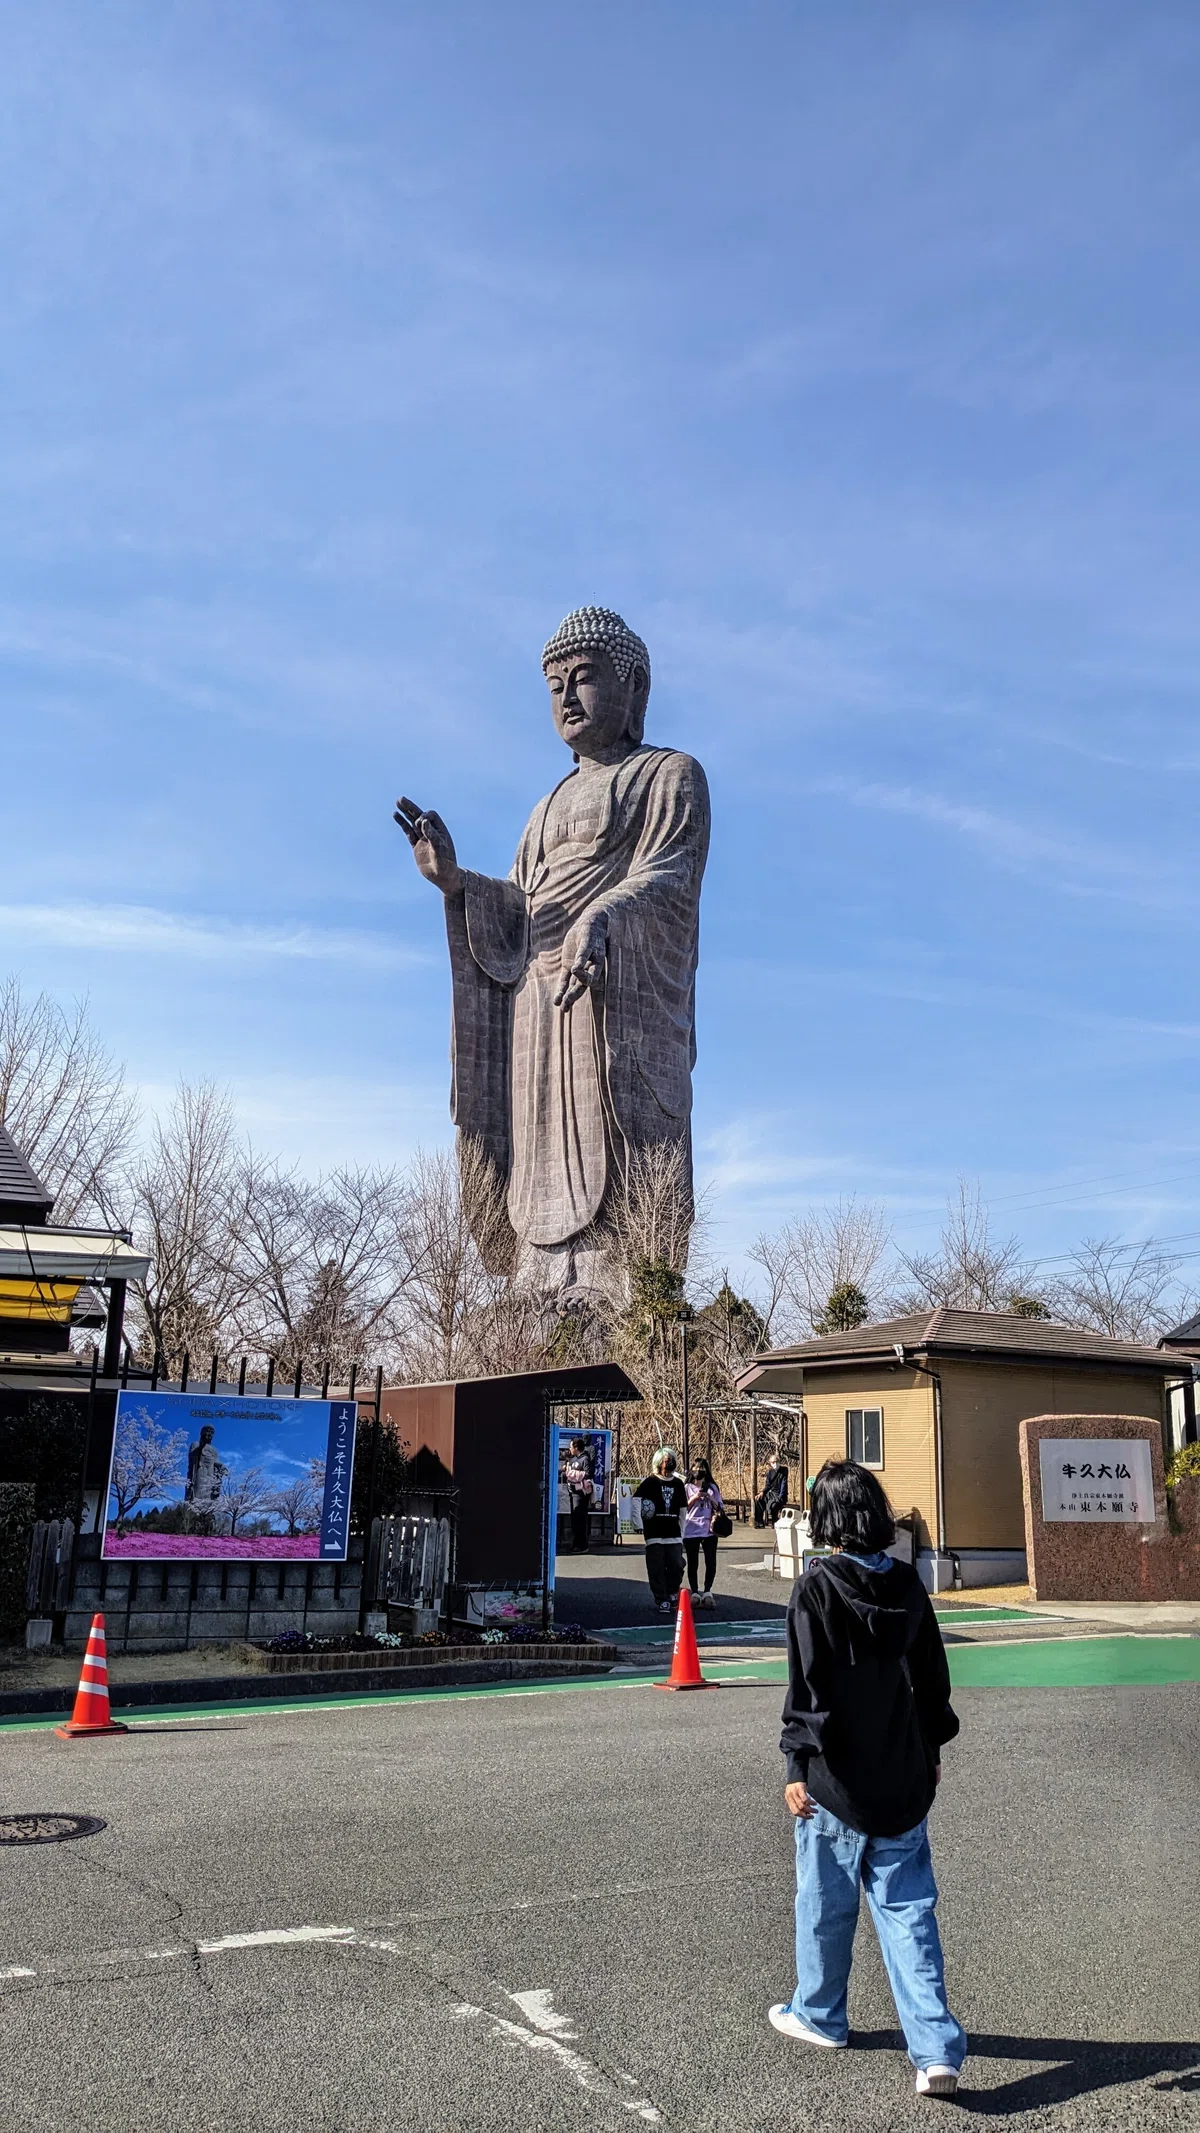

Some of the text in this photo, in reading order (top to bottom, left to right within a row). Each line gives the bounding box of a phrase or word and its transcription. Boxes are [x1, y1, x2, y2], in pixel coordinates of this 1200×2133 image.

[327, 1407, 349, 1536] ようこそ牛久大仏へ
[1062, 1463, 1132, 1479] 牛久大仏
[661, 1485, 675, 1494] Ling
